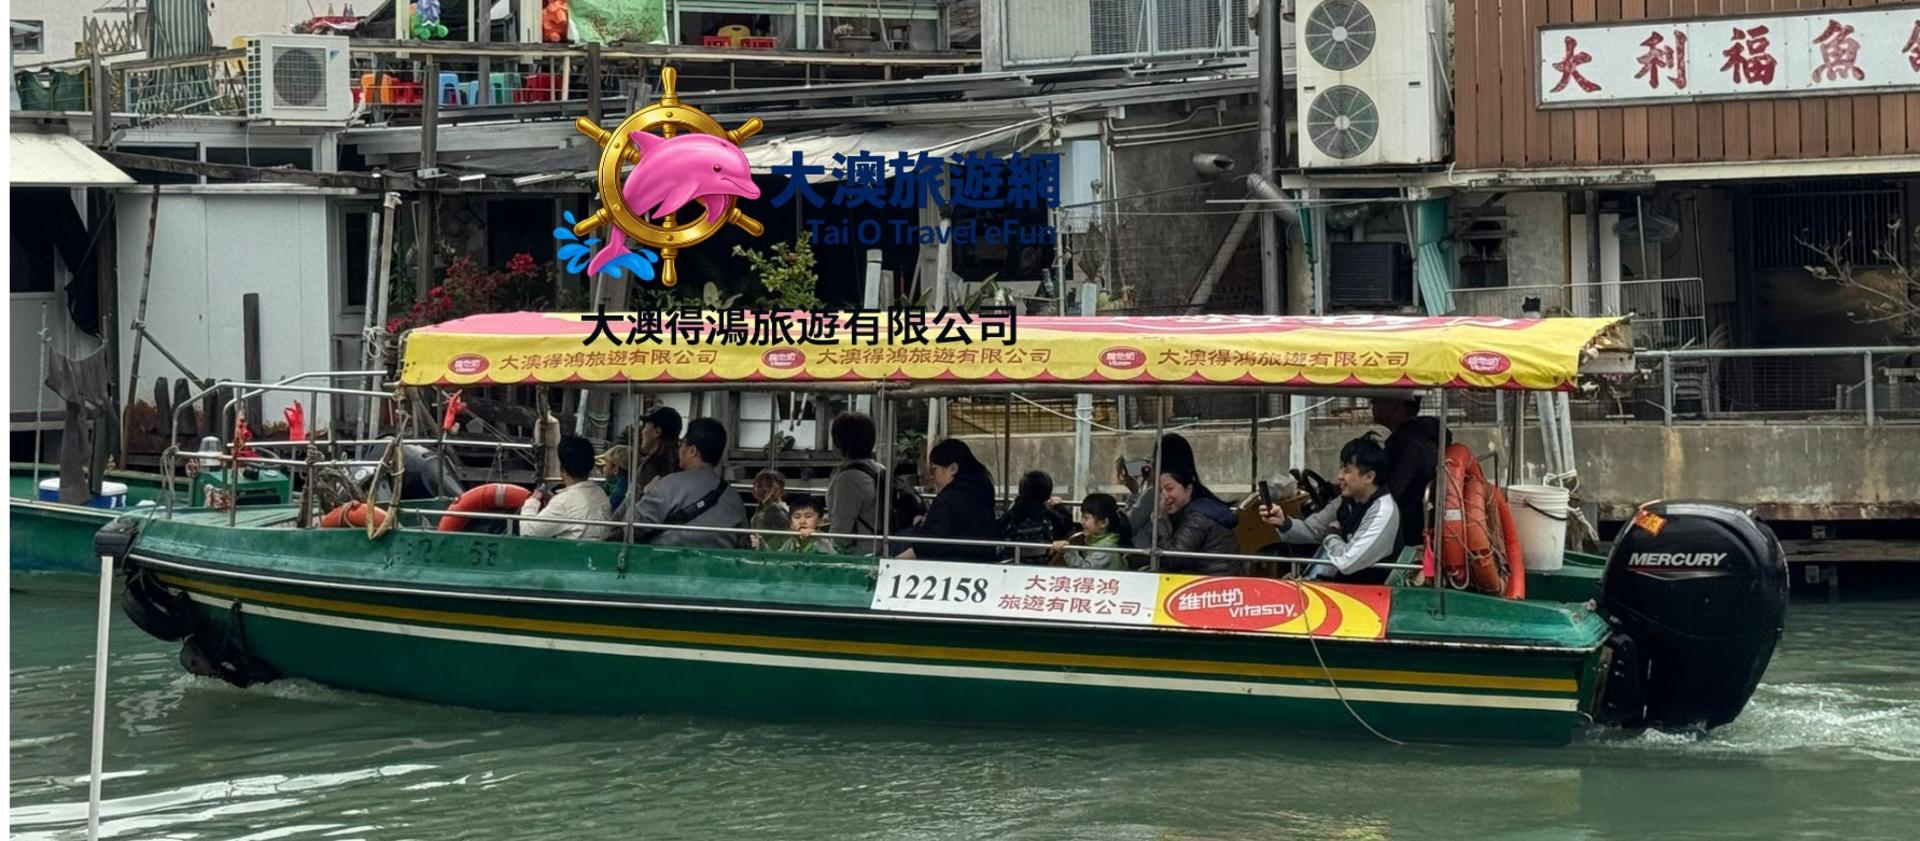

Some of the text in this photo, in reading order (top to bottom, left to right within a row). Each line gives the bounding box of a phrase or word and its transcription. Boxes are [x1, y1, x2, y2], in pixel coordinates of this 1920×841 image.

[1628, 552, 1728, 567] MERCURY
[889, 574, 988, 603] 122158
[1024, 574, 1120, 596] 大澳得鴻
[997, 594, 1142, 617] 旅遊有限公司
[1178, 588, 1244, 611] 維他奶
